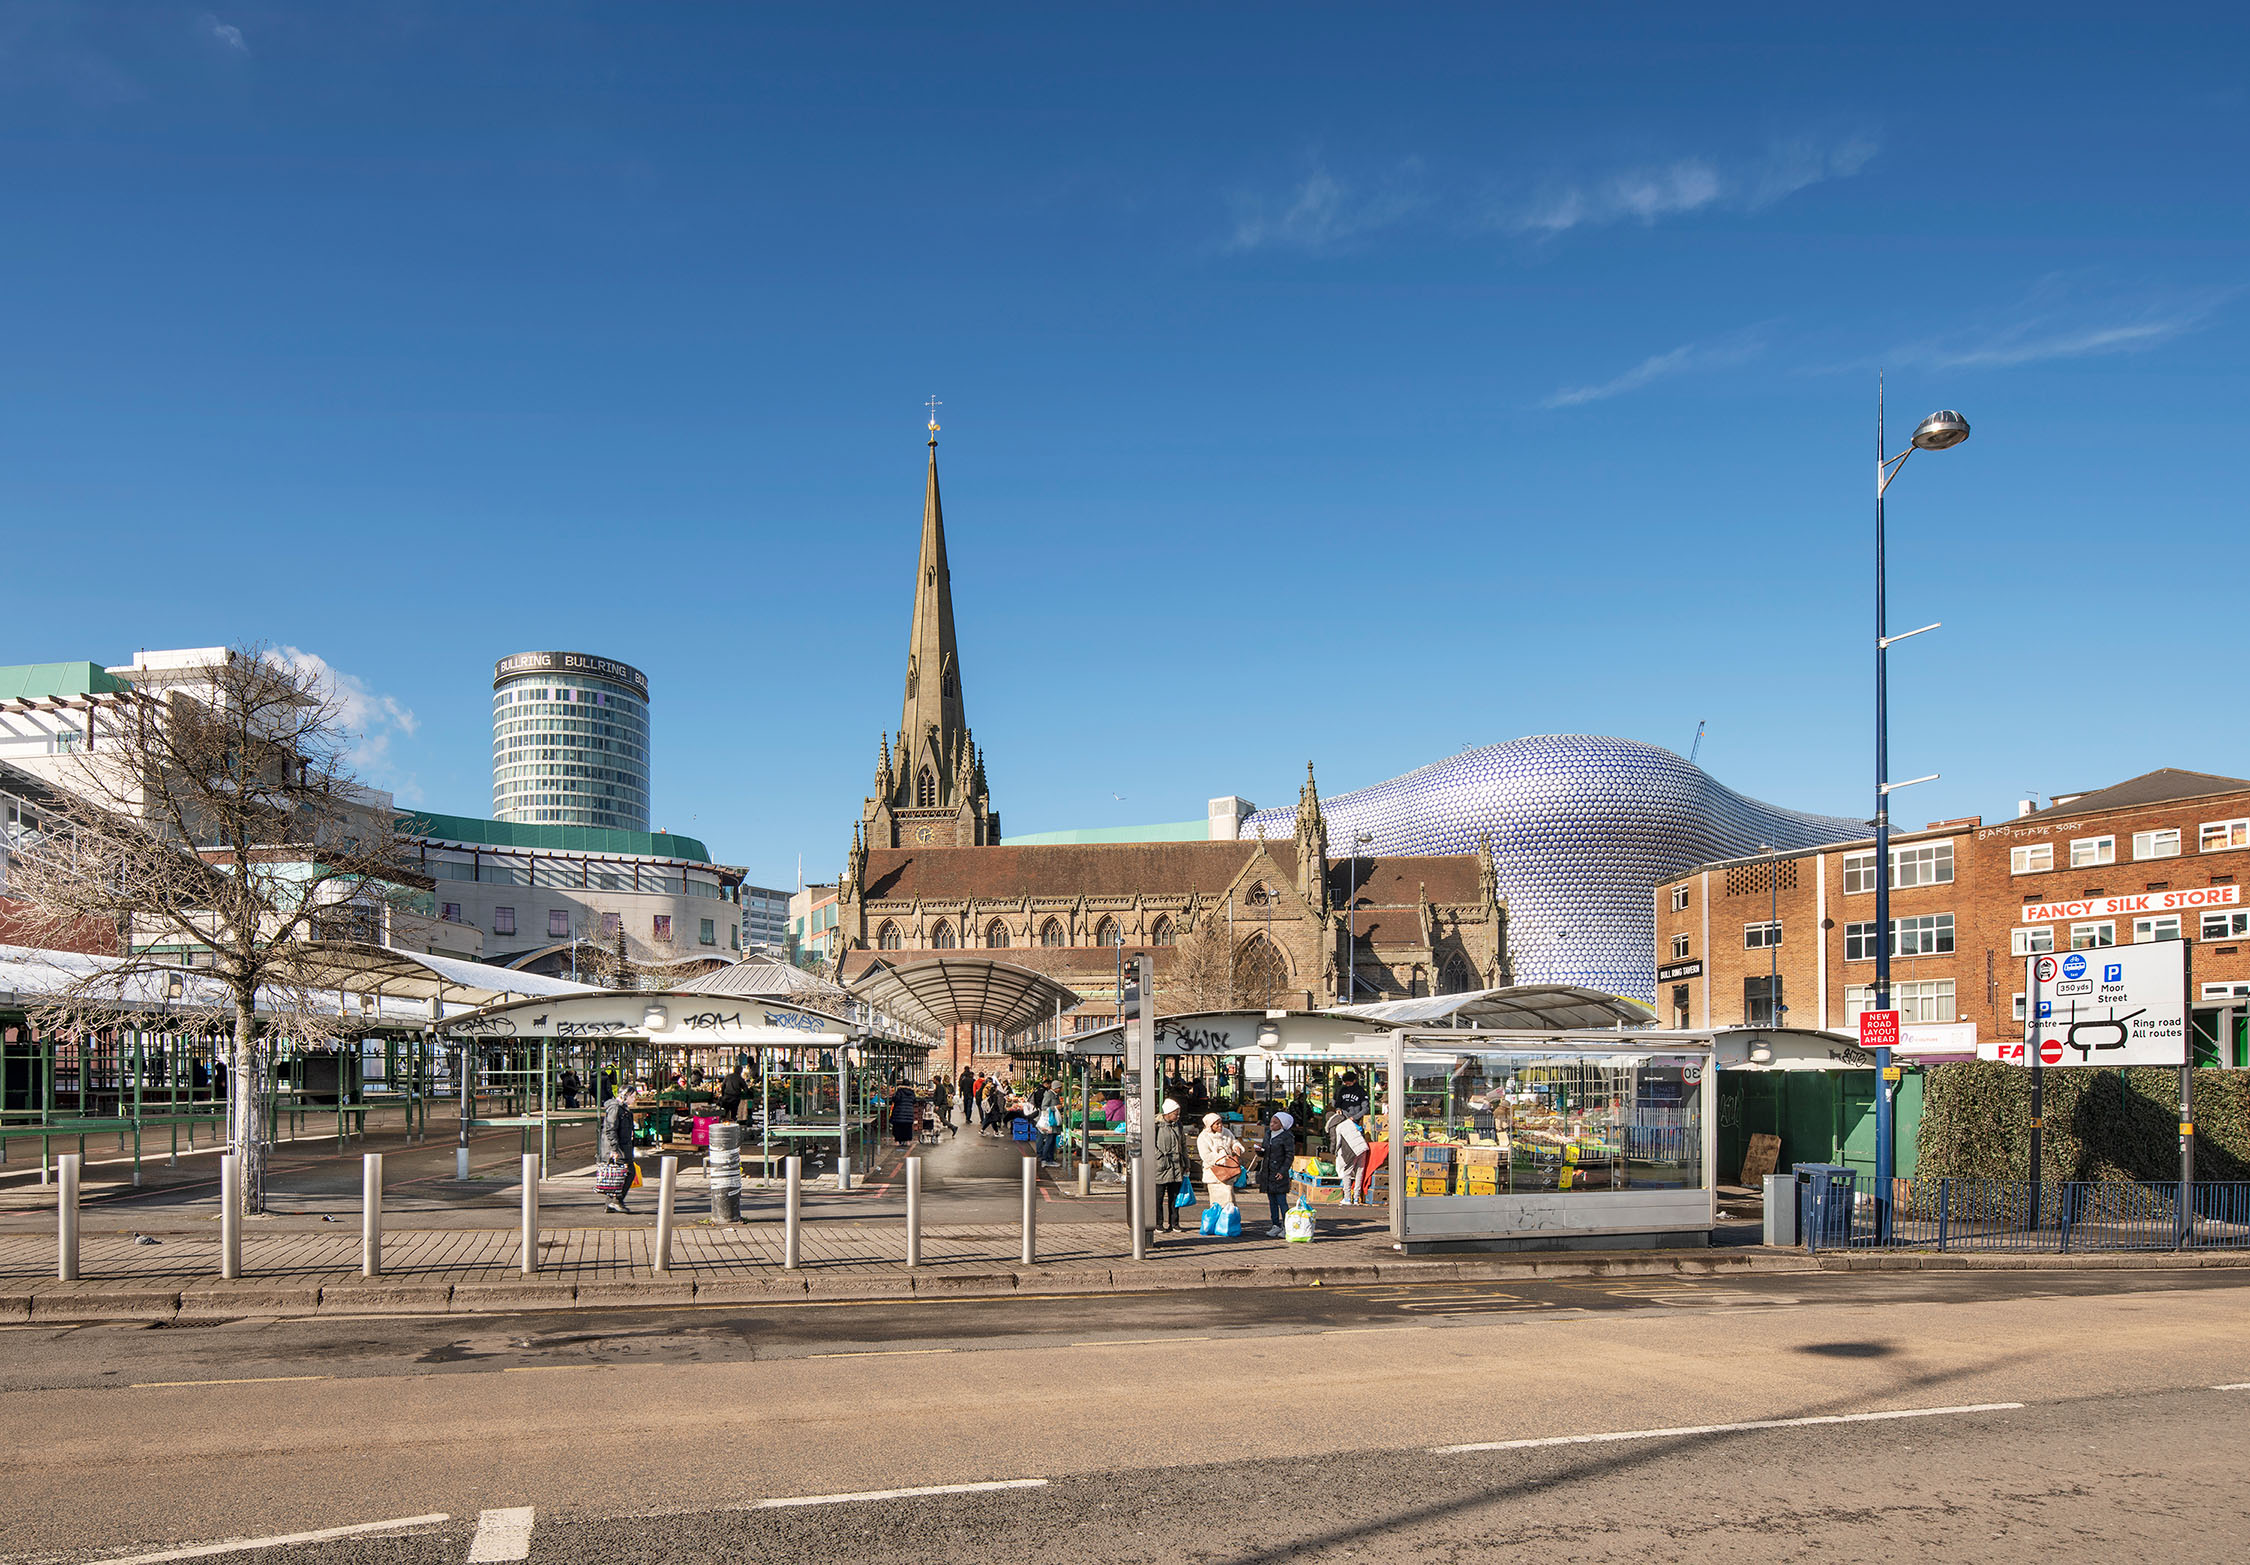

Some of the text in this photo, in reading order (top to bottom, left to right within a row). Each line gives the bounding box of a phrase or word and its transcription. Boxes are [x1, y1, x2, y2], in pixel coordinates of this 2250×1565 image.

[500, 655, 551, 672] BULLRING
[565, 656, 627, 678] BULLRING
[1978, 823, 2083, 840] BARS FLAVE SORT
[2028, 888, 2233, 920] FANCY SILK STORE
[1660, 964, 1700, 979] BULL RING TAVERN
[2076, 984, 2089, 992] yds
[2101, 984, 2124, 992] Moor
[2098, 994, 2127, 1003] Street
[2028, 1020, 2057, 1028] Centre
[2133, 1018, 2181, 1028] Ring road
[2133, 1029, 2182, 1038] All routes
